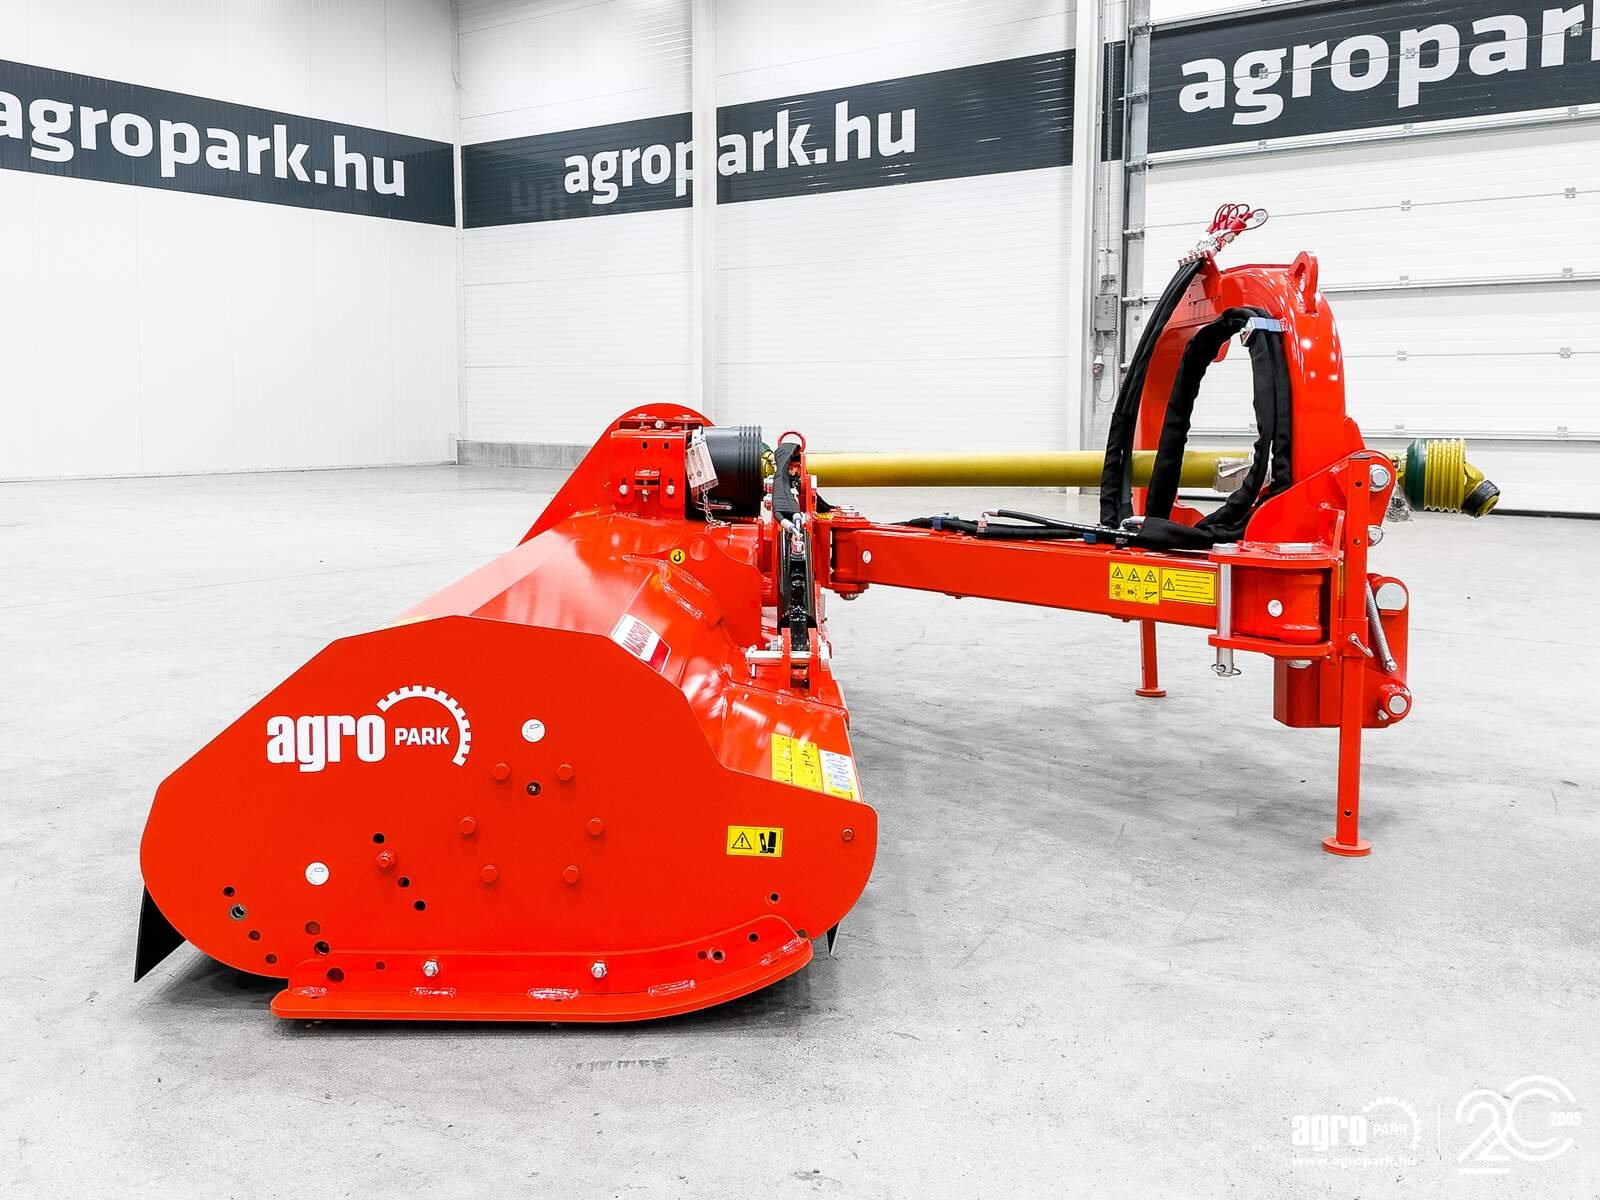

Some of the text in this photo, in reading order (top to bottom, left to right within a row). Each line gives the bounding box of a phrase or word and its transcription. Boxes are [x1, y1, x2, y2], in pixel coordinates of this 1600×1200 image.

[1179, 0, 1600, 126] agropar
[266, 714, 450, 772] agro PARK
